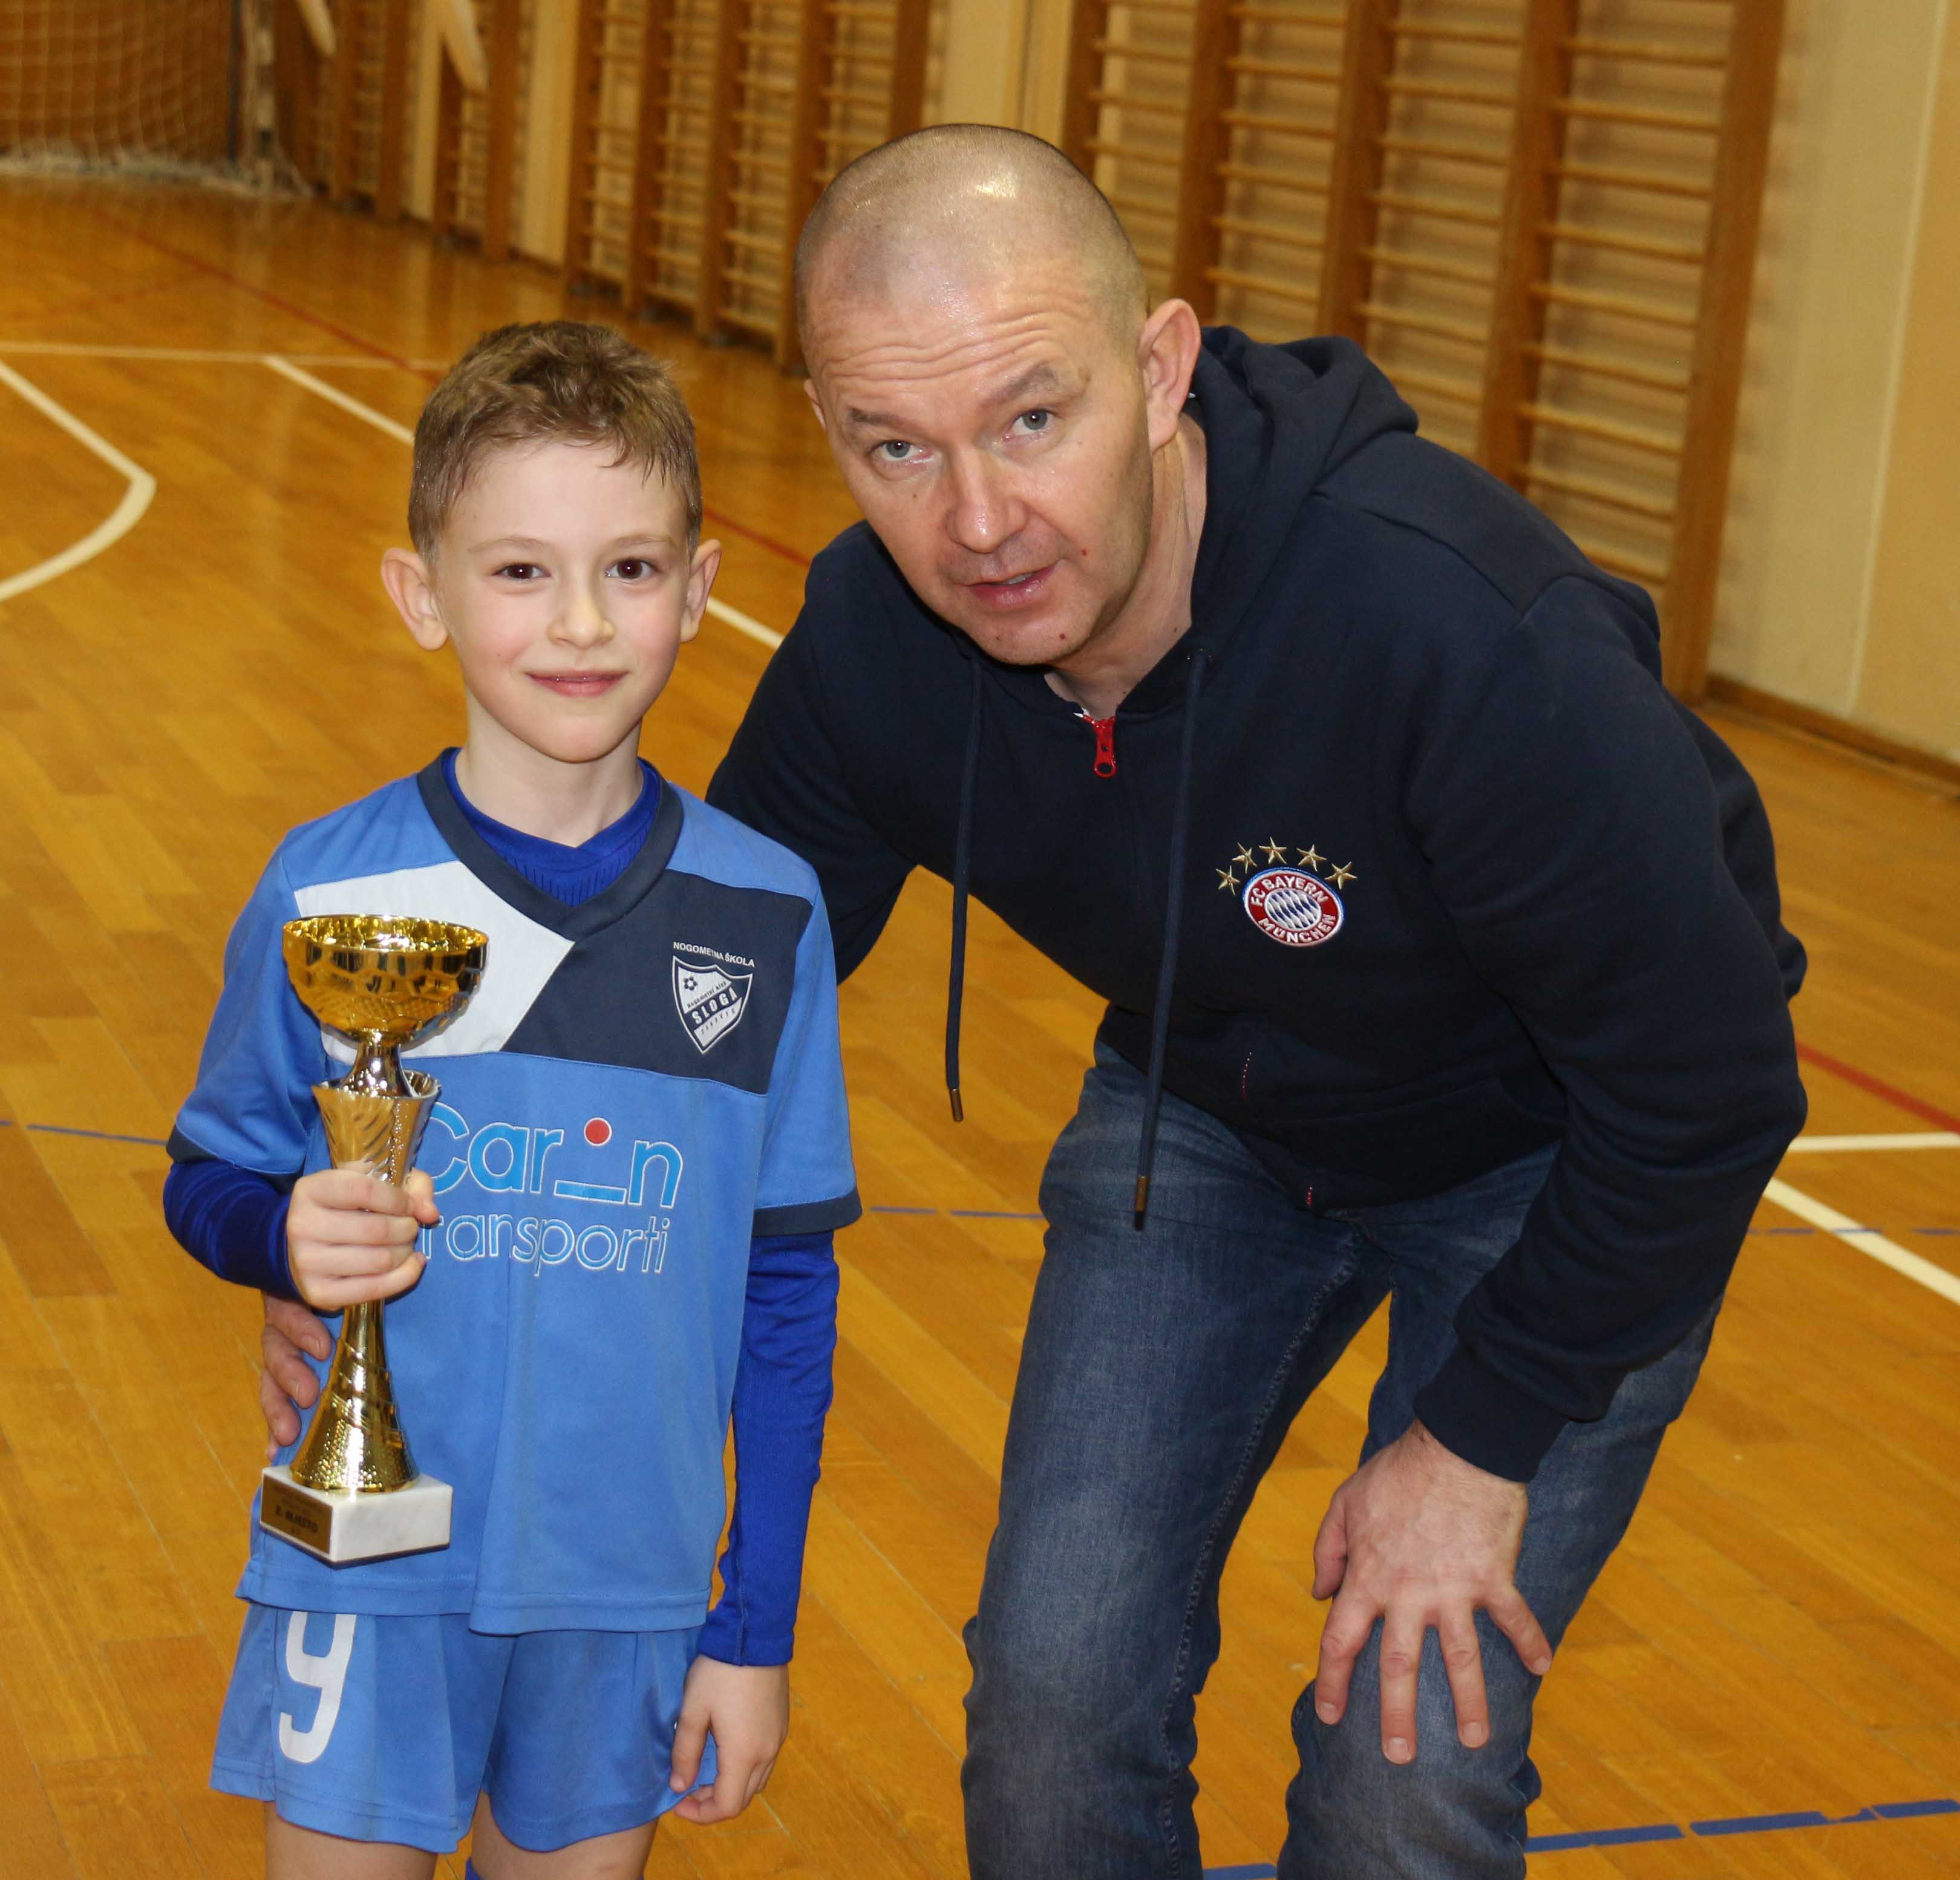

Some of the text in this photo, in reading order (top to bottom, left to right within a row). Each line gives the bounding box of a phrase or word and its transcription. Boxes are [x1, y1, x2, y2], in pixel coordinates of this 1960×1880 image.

[1250, 875, 1329, 907] FC BAYERN
[673, 941, 755, 968] NOGOMETNA ŠKOLA
[691, 987, 738, 1025] SLOGA
[422, 1213, 671, 1277] ransporti
[278, 1610, 358, 1764] 9
